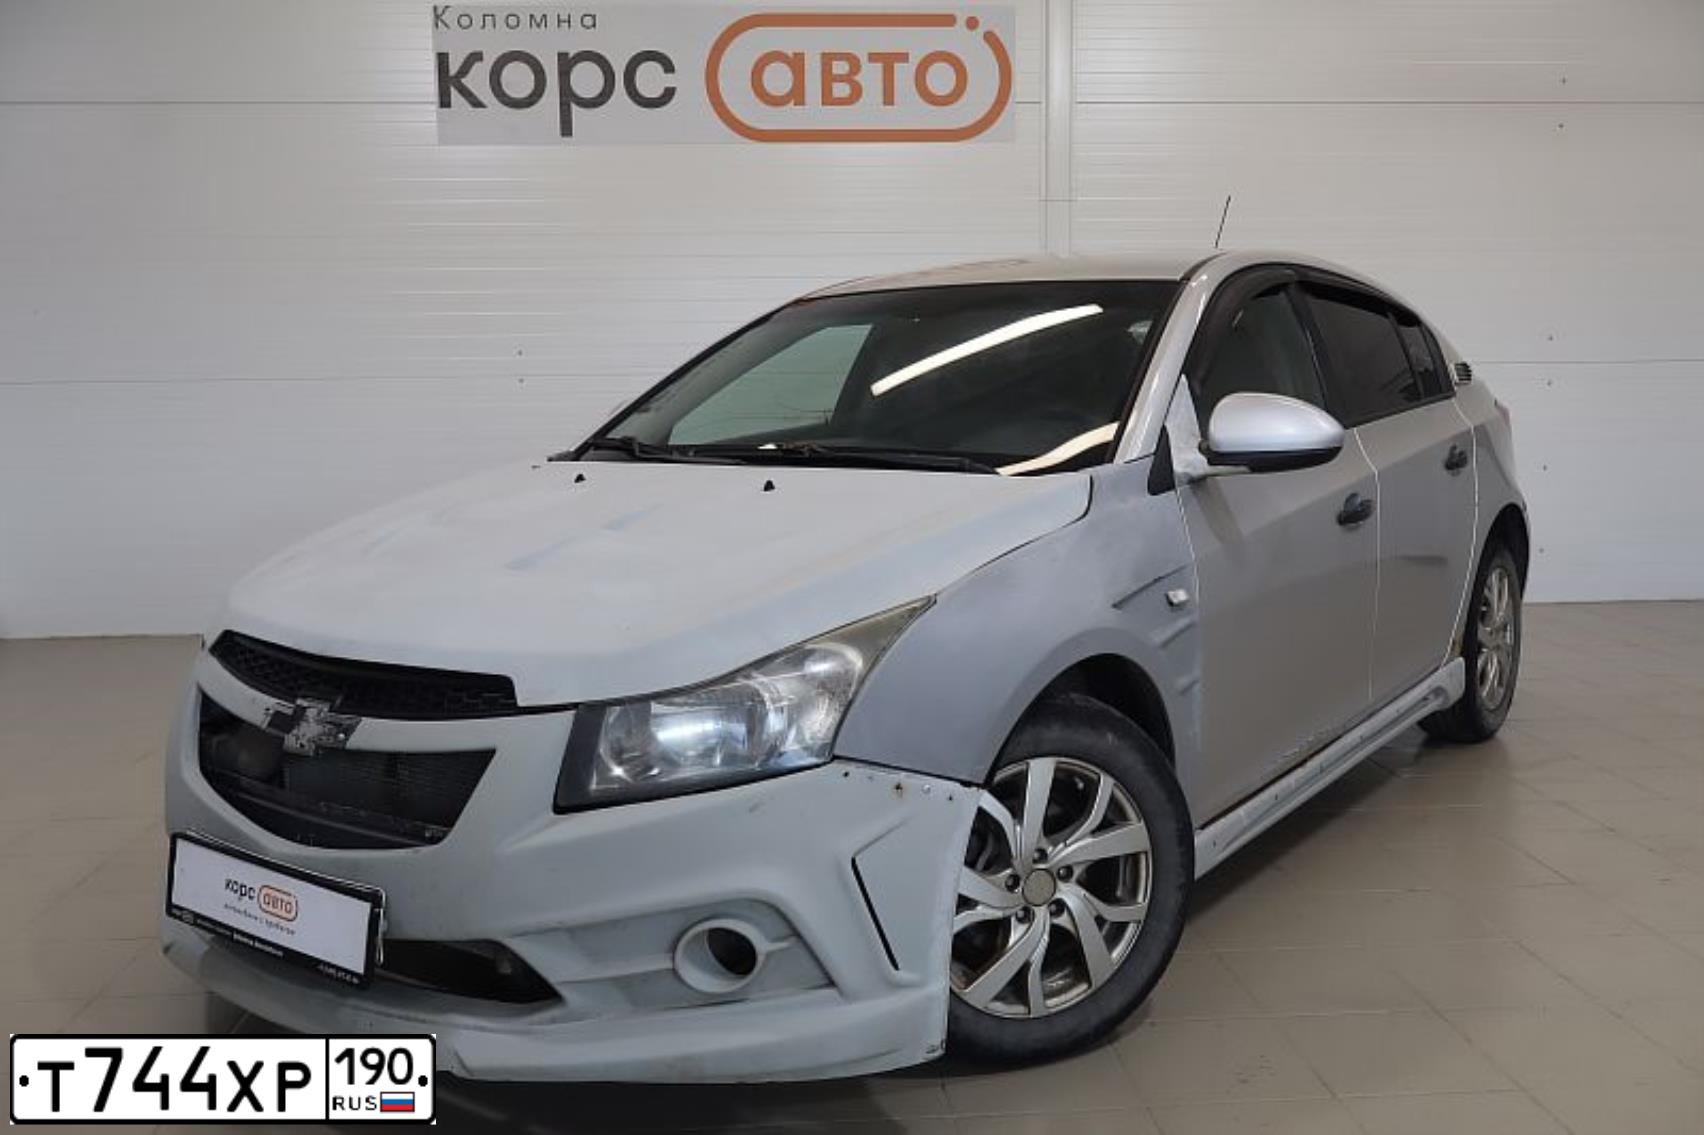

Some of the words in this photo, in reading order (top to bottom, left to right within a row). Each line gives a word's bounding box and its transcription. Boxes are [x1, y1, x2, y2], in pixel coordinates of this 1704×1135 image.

[433, 5, 597, 30] Коломна
[437, 49, 676, 137] корс
[751, 50, 968, 107] авто
